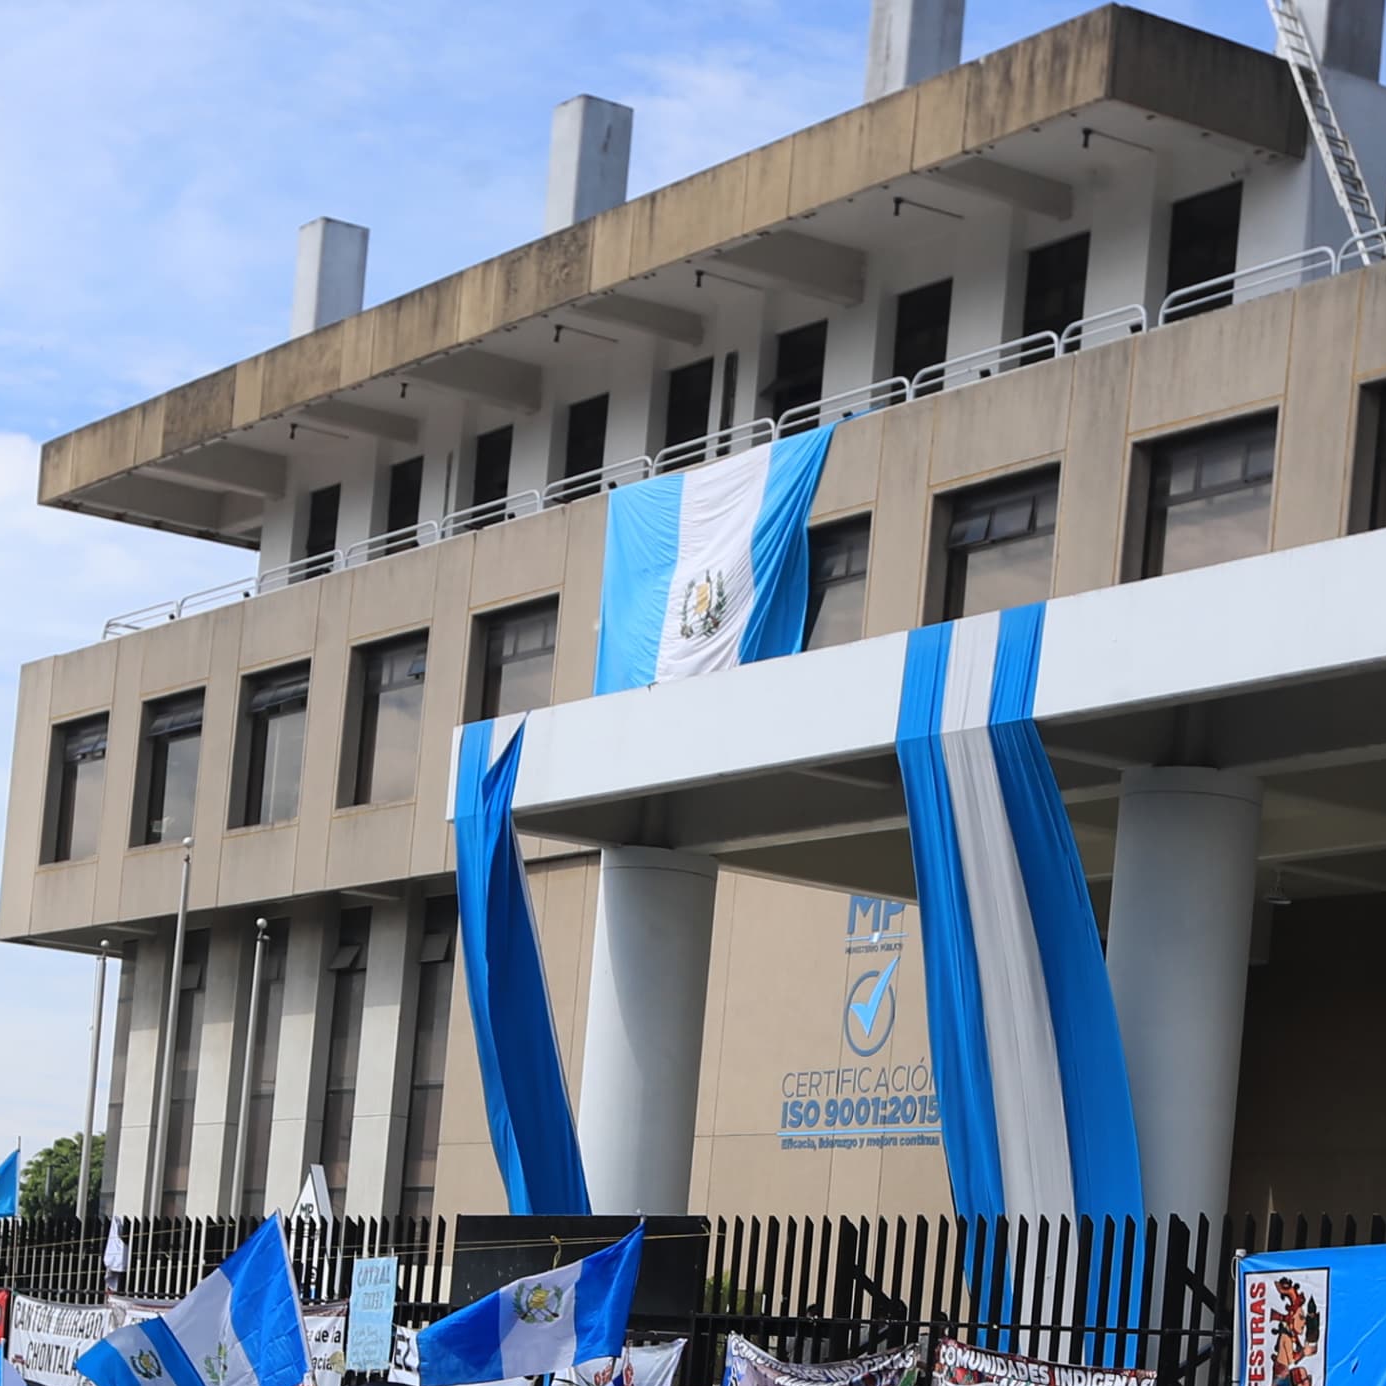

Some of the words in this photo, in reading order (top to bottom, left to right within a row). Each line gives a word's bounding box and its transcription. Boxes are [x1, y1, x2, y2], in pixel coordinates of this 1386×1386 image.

[781, 1098, 825, 1129] ISO
[825, 1094, 941, 1127] 9001:2015
[939, 1343, 1050, 1385] COMUNIDADES
